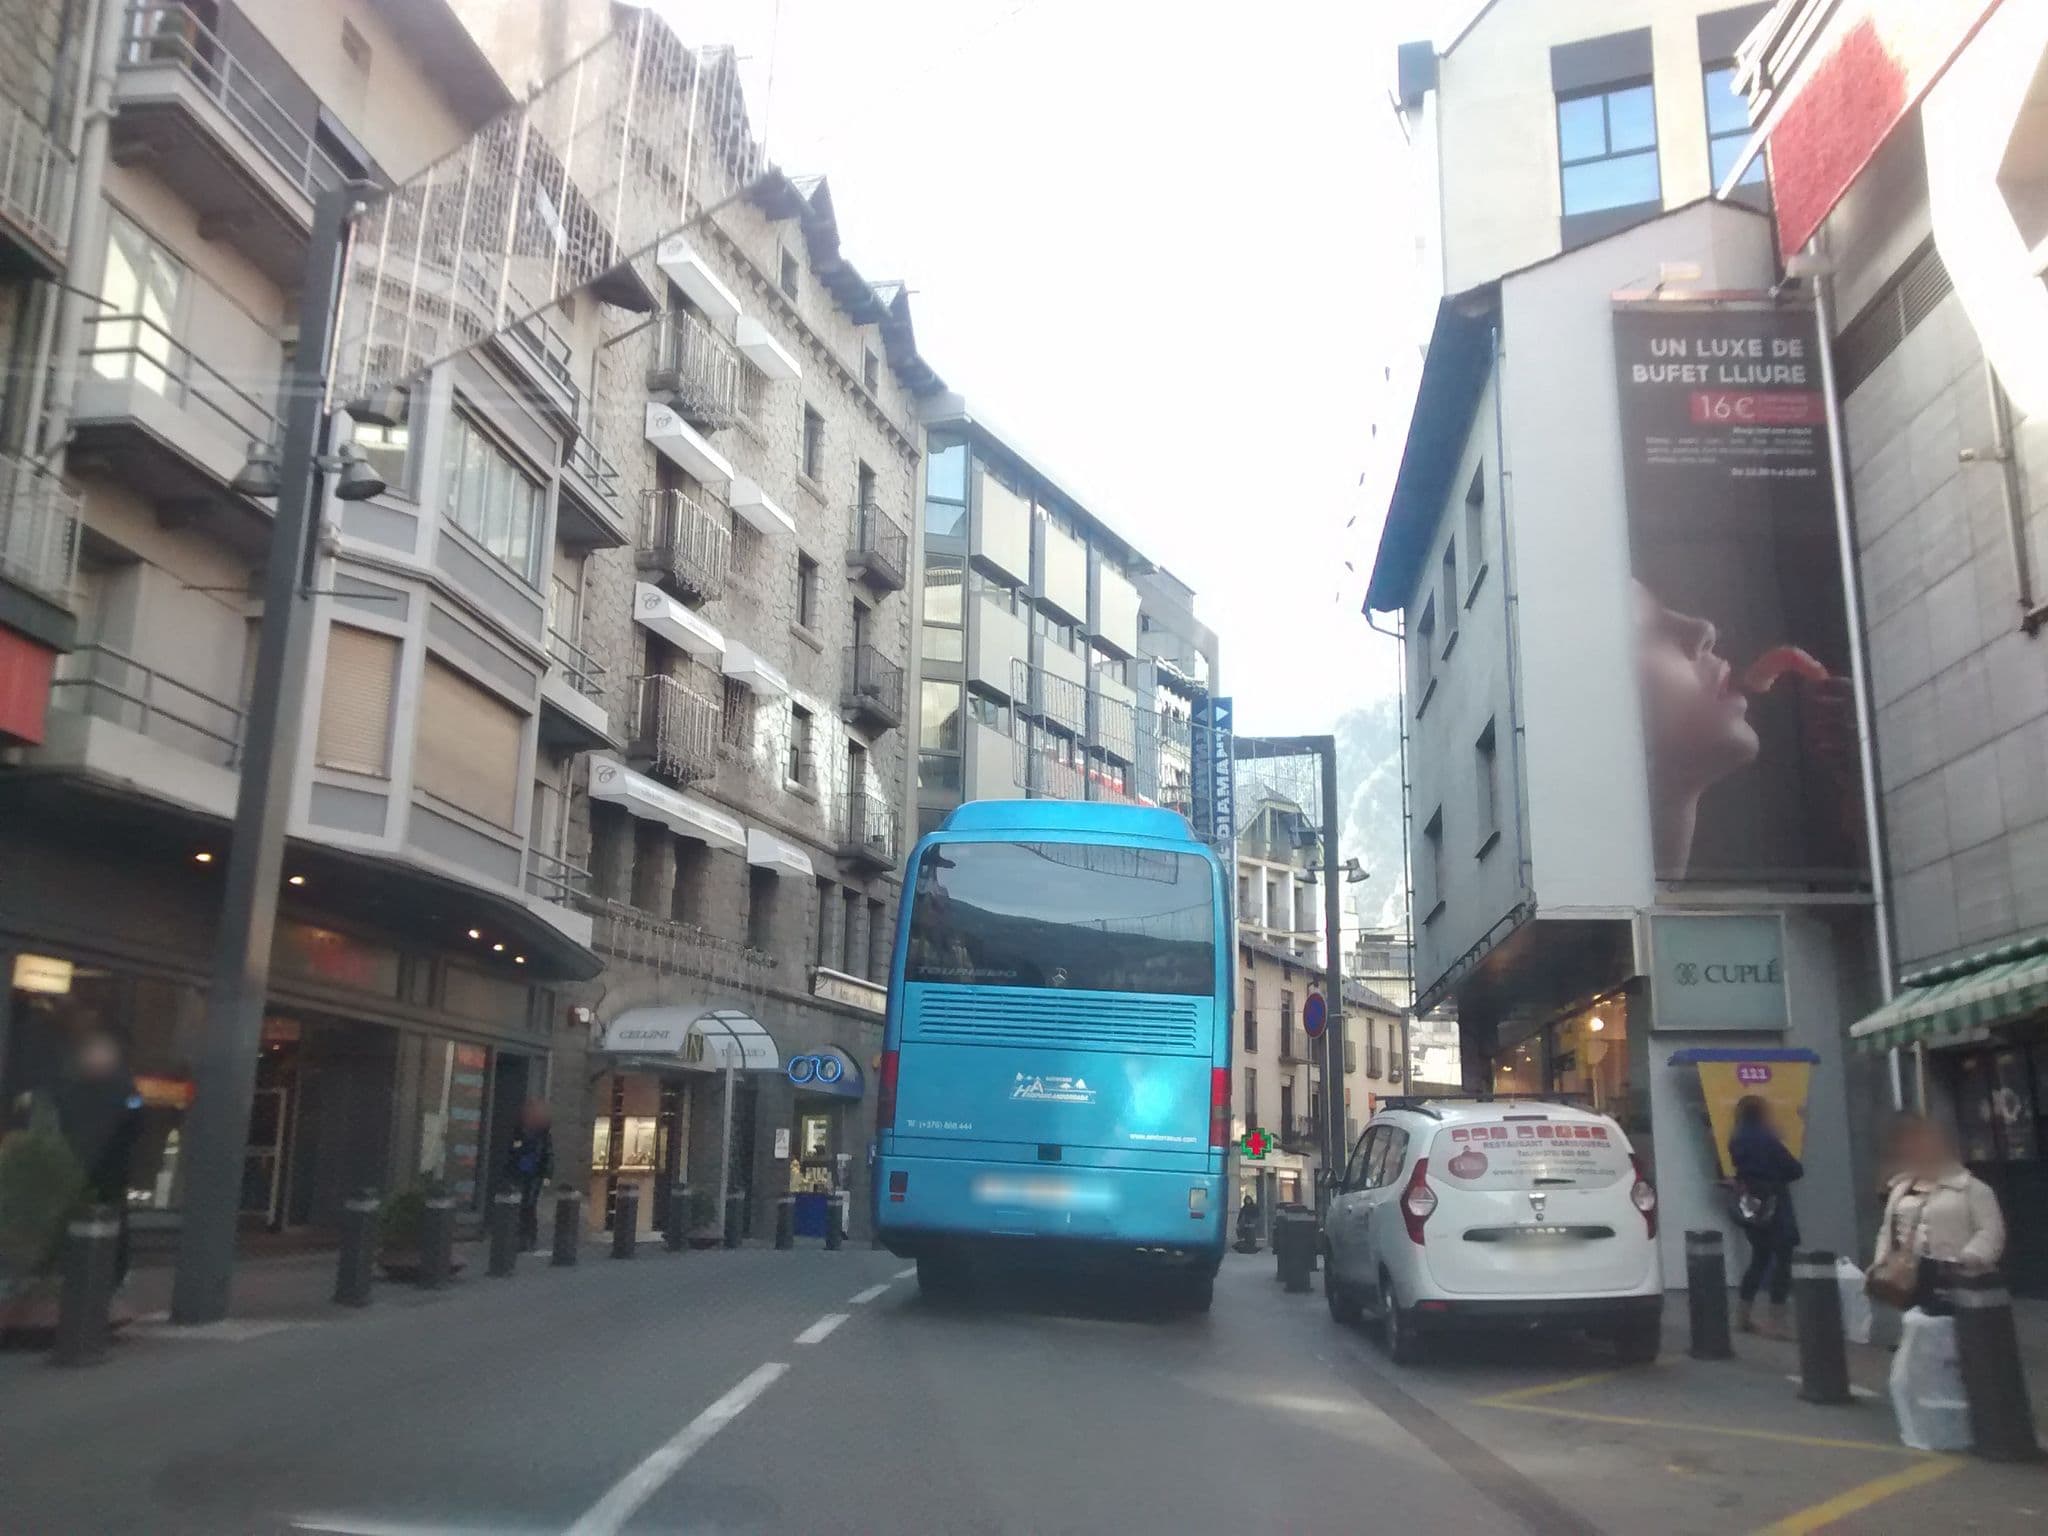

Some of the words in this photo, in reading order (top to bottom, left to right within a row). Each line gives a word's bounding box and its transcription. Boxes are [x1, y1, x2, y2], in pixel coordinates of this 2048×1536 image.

[1651, 339, 1686, 357] UN
[1696, 339, 1763, 357] LUXE
[1772, 339, 1804, 357] DE
[1633, 365, 1709, 383] BUFET
[1719, 365, 1806, 383] LLIURE
[1704, 958, 1779, 984] CUPLÉ
